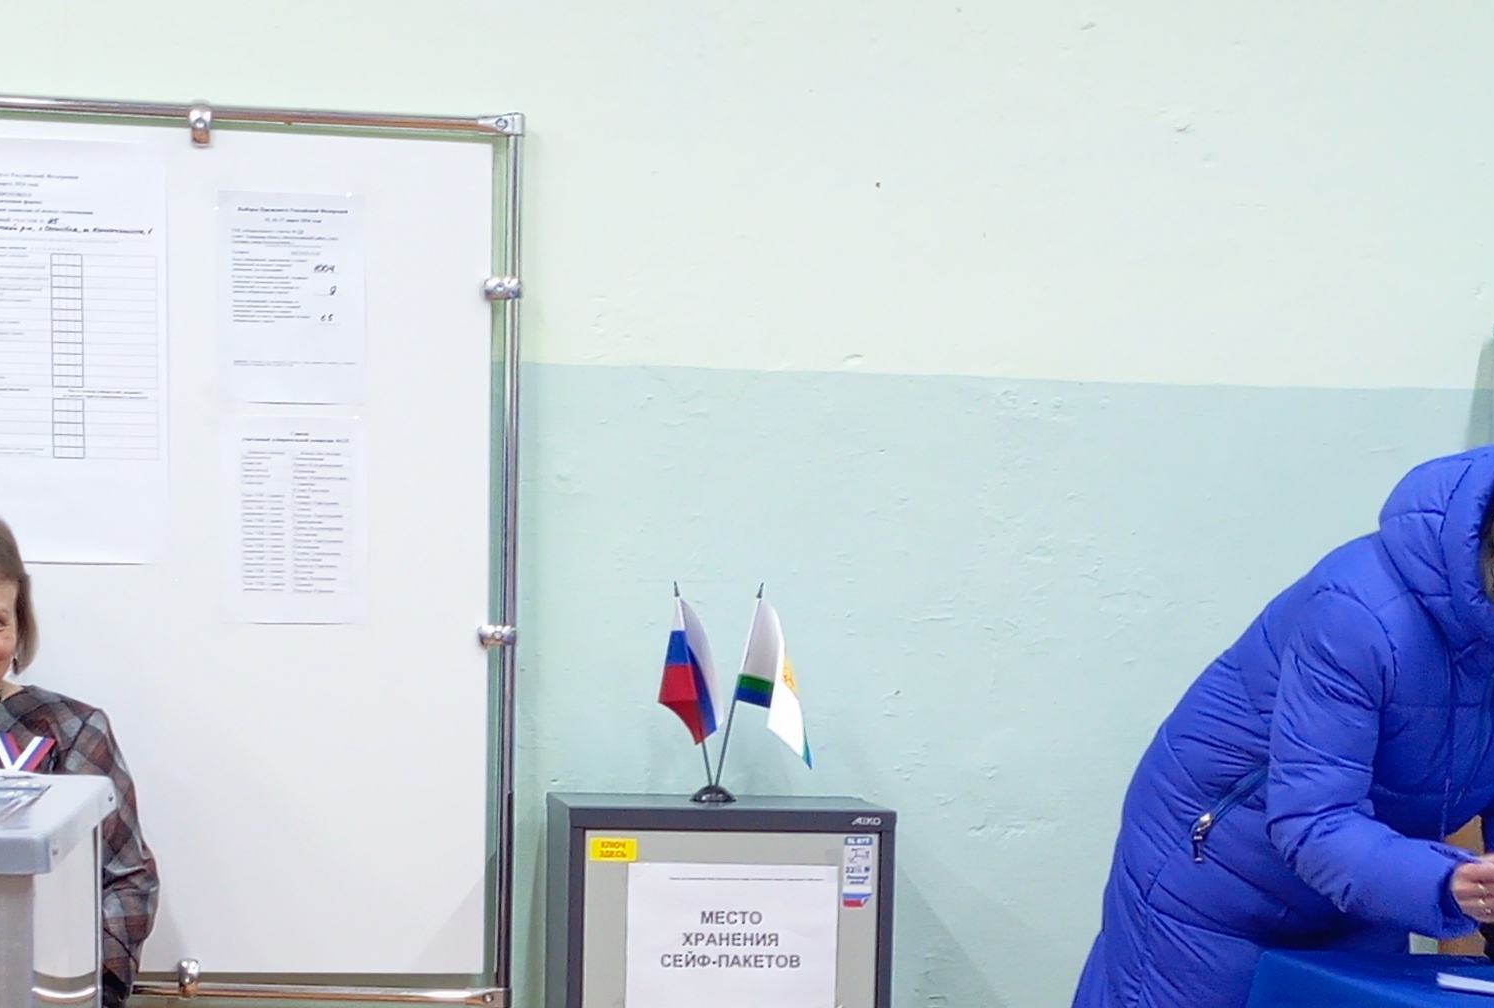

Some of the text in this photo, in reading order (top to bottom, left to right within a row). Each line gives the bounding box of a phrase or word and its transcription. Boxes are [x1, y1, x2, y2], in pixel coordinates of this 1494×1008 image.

[700, 911, 763, 925] МЕСТО
[681, 932, 779, 946] ХРАНЕНИЯ
[660, 951, 801, 968] СЕЙФ-ПАКЕТОВ
